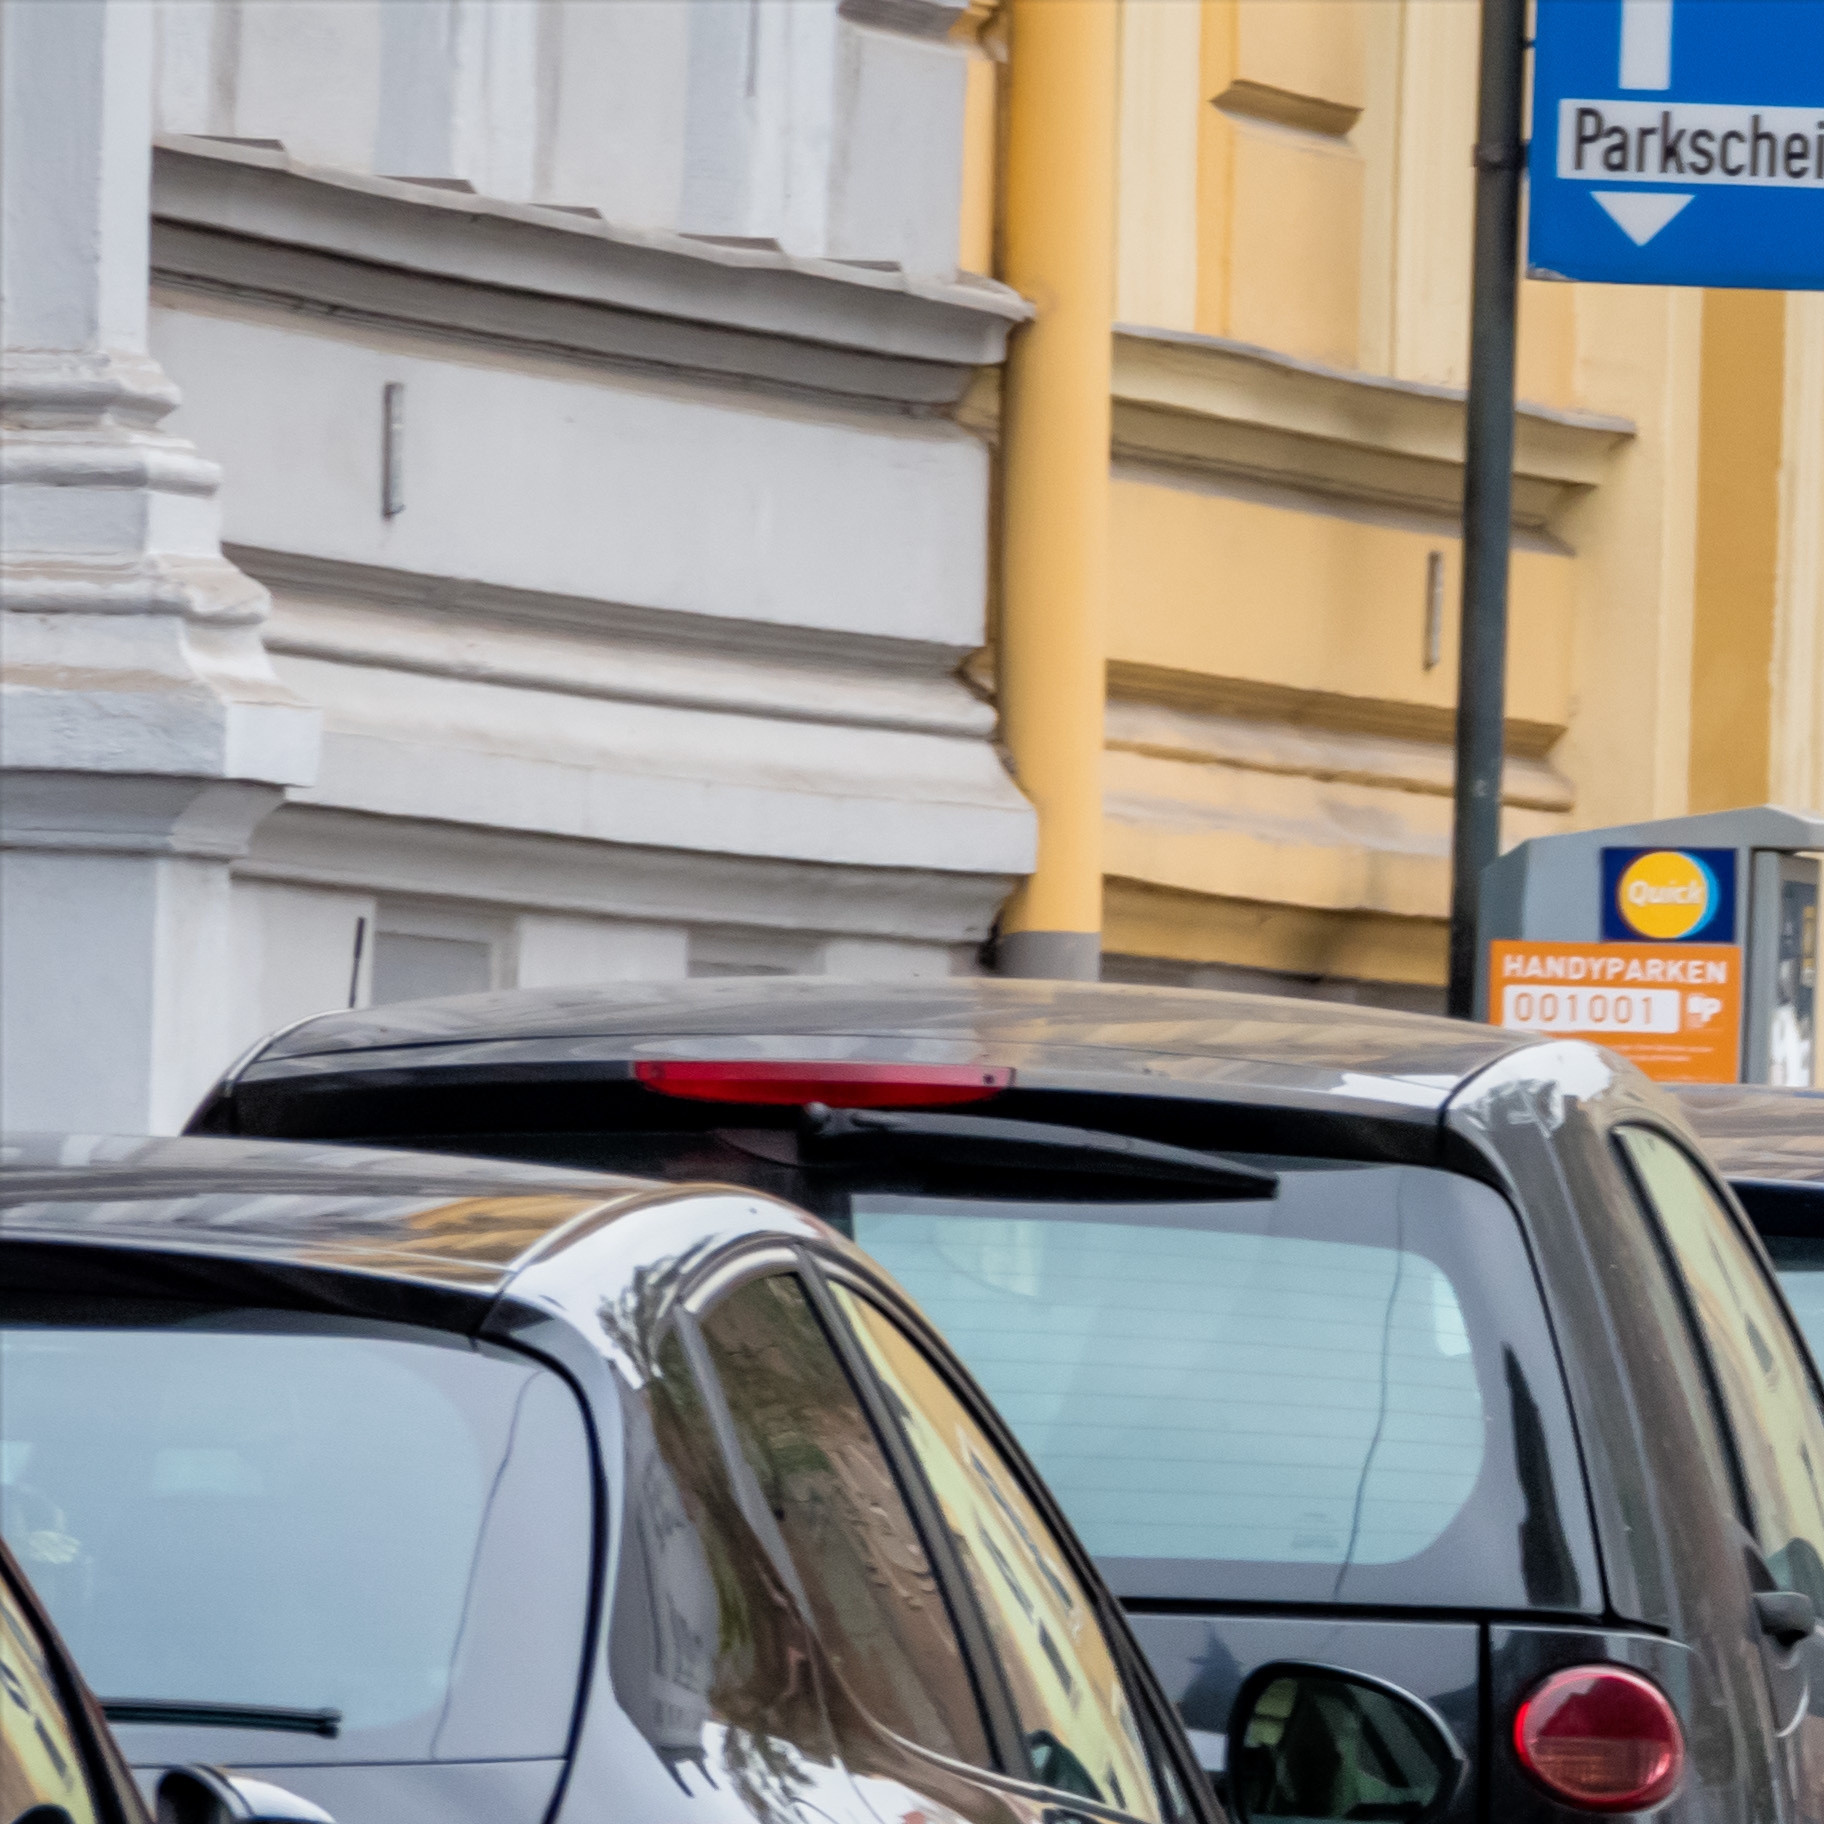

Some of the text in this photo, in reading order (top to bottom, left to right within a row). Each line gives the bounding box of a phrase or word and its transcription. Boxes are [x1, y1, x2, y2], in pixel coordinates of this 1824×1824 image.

[1628, 880, 1703, 908] Quick
[1503, 954, 1728, 985] HANDYPARKEN
[1514, 992, 1653, 1025] 001001
